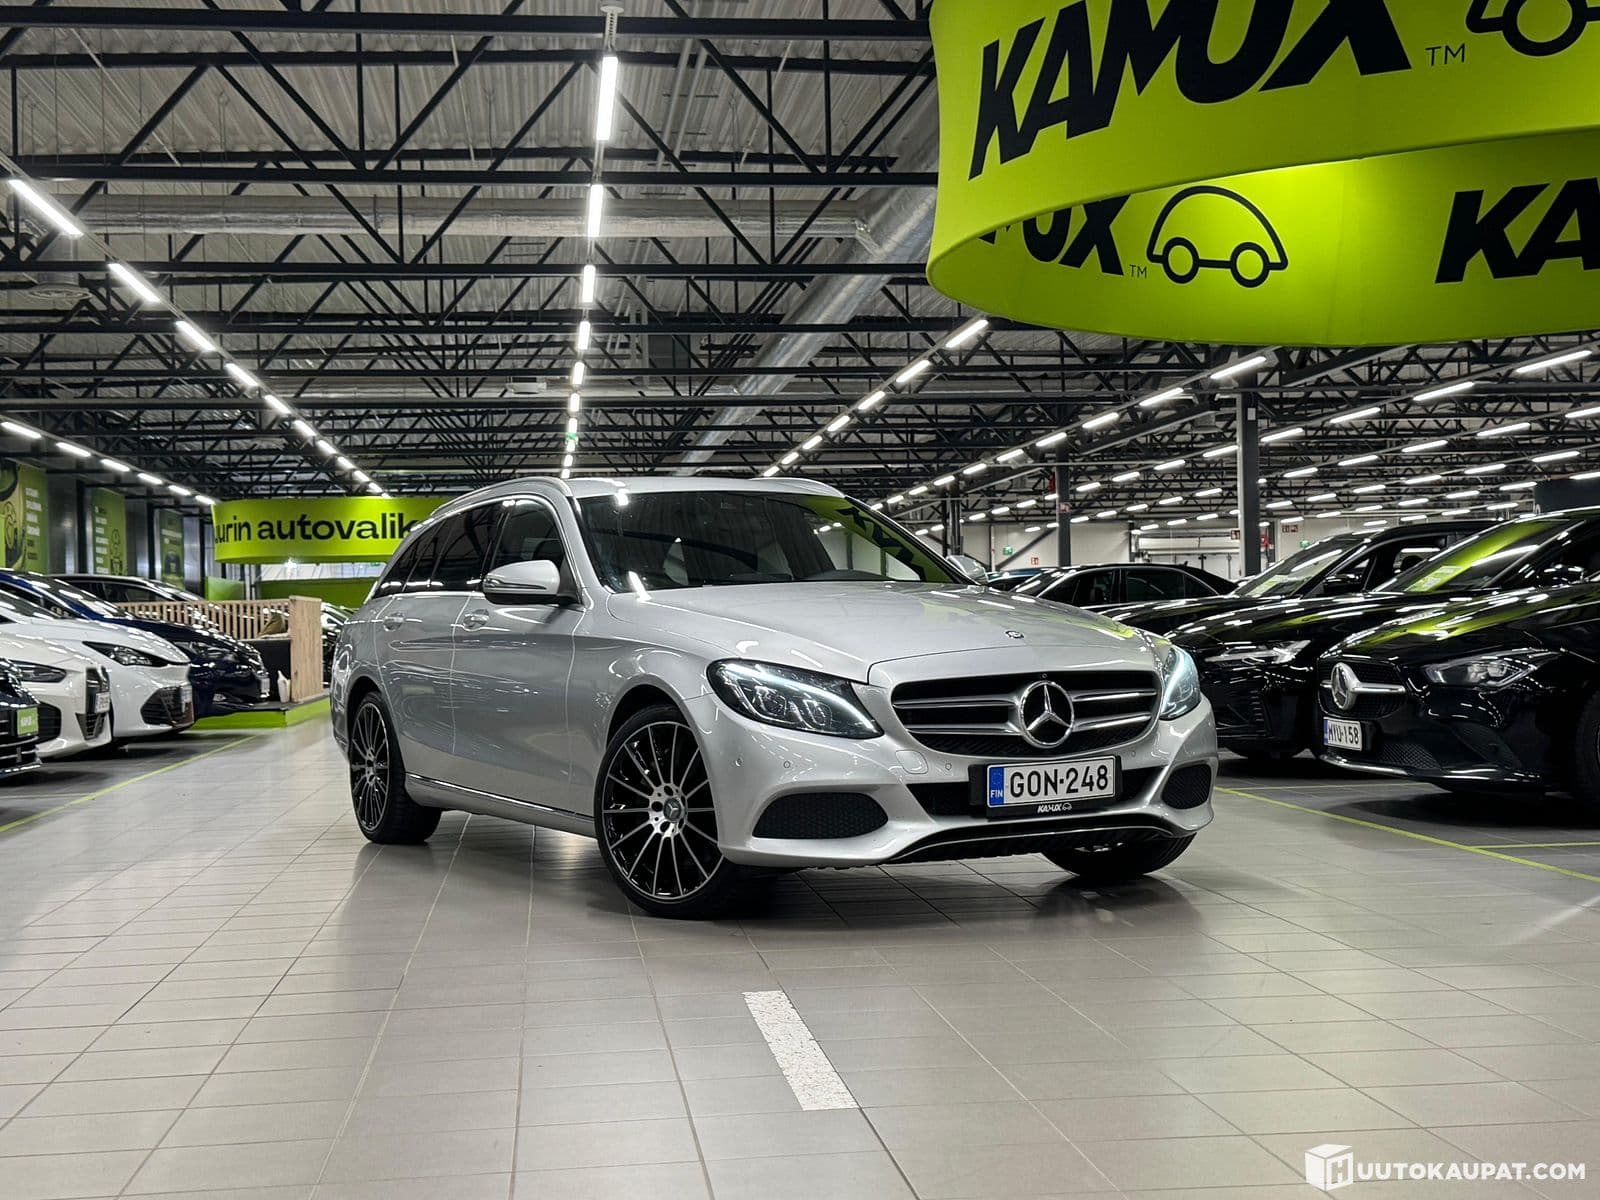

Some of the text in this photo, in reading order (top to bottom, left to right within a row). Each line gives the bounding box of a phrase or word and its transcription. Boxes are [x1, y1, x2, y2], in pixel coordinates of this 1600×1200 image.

[214, 514, 252, 544] urin
[990, 764, 1109, 799] FIN GON-248
